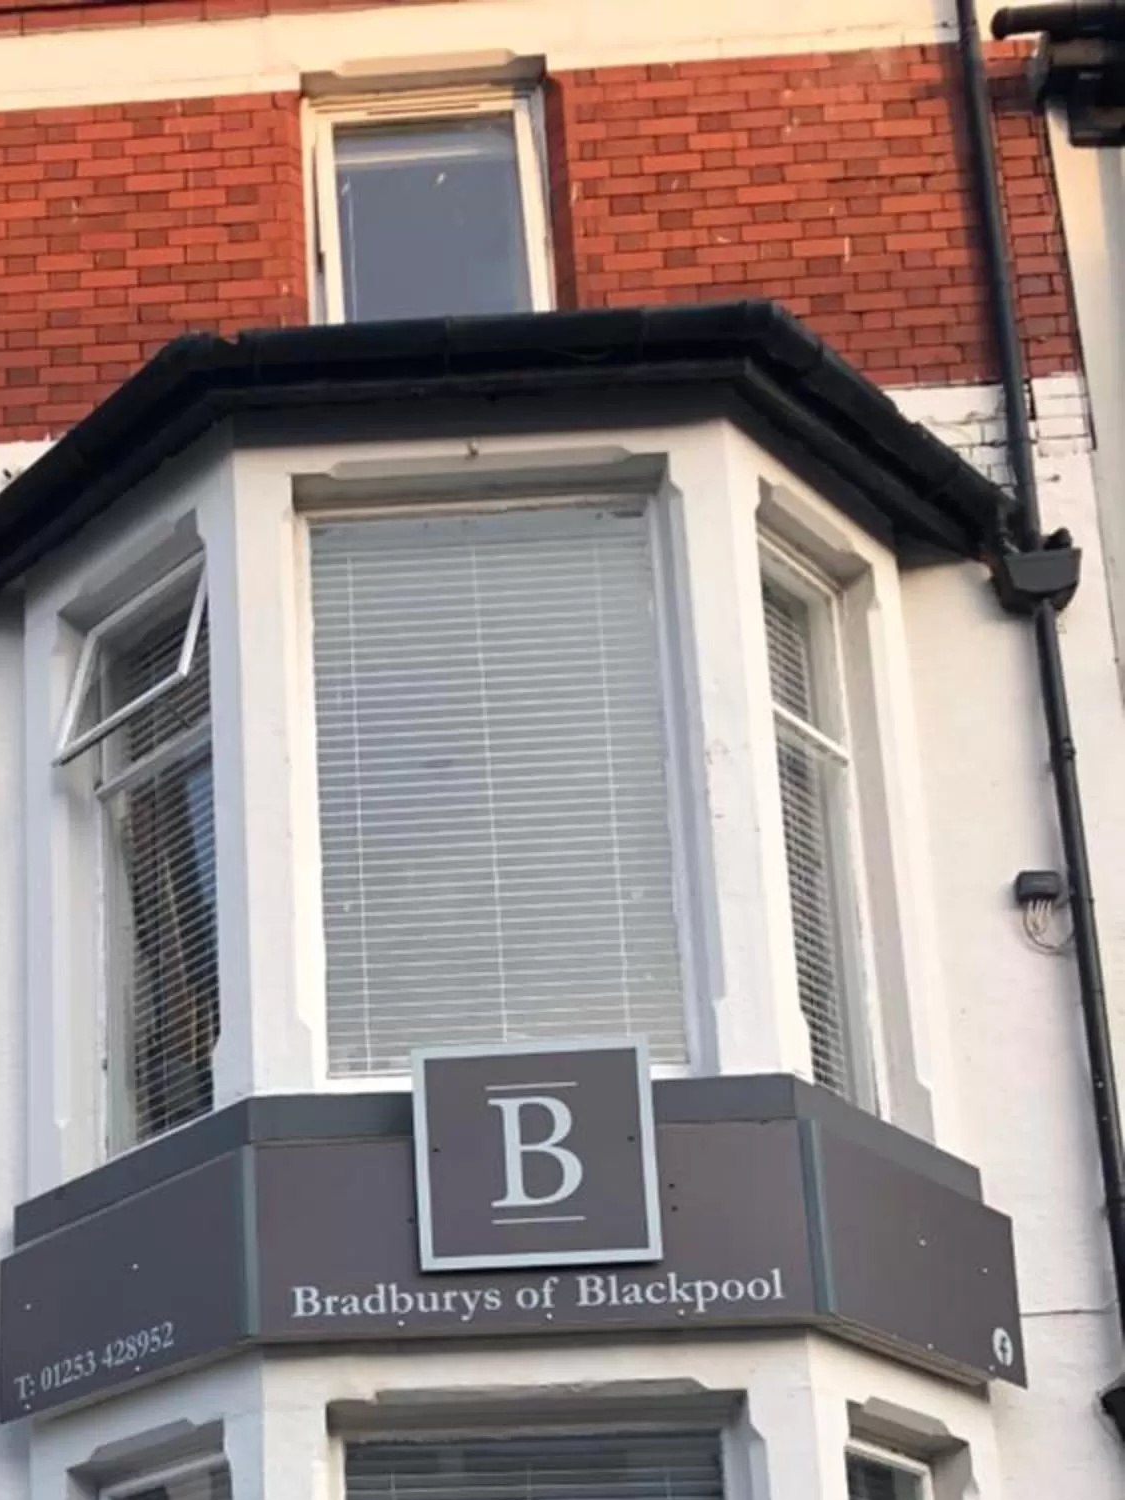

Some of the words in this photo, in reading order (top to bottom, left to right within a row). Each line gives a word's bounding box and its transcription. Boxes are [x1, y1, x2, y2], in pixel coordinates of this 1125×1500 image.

[487, 1096, 583, 1208] B
[291, 1282, 502, 1321] Bradburys
[515, 1277, 560, 1308] of
[575, 1269, 784, 1312] Blackpool
[14, 1373, 36, 1400] T:
[40, 1350, 97, 1391] 01253
[101, 1320, 174, 1369] 428952
